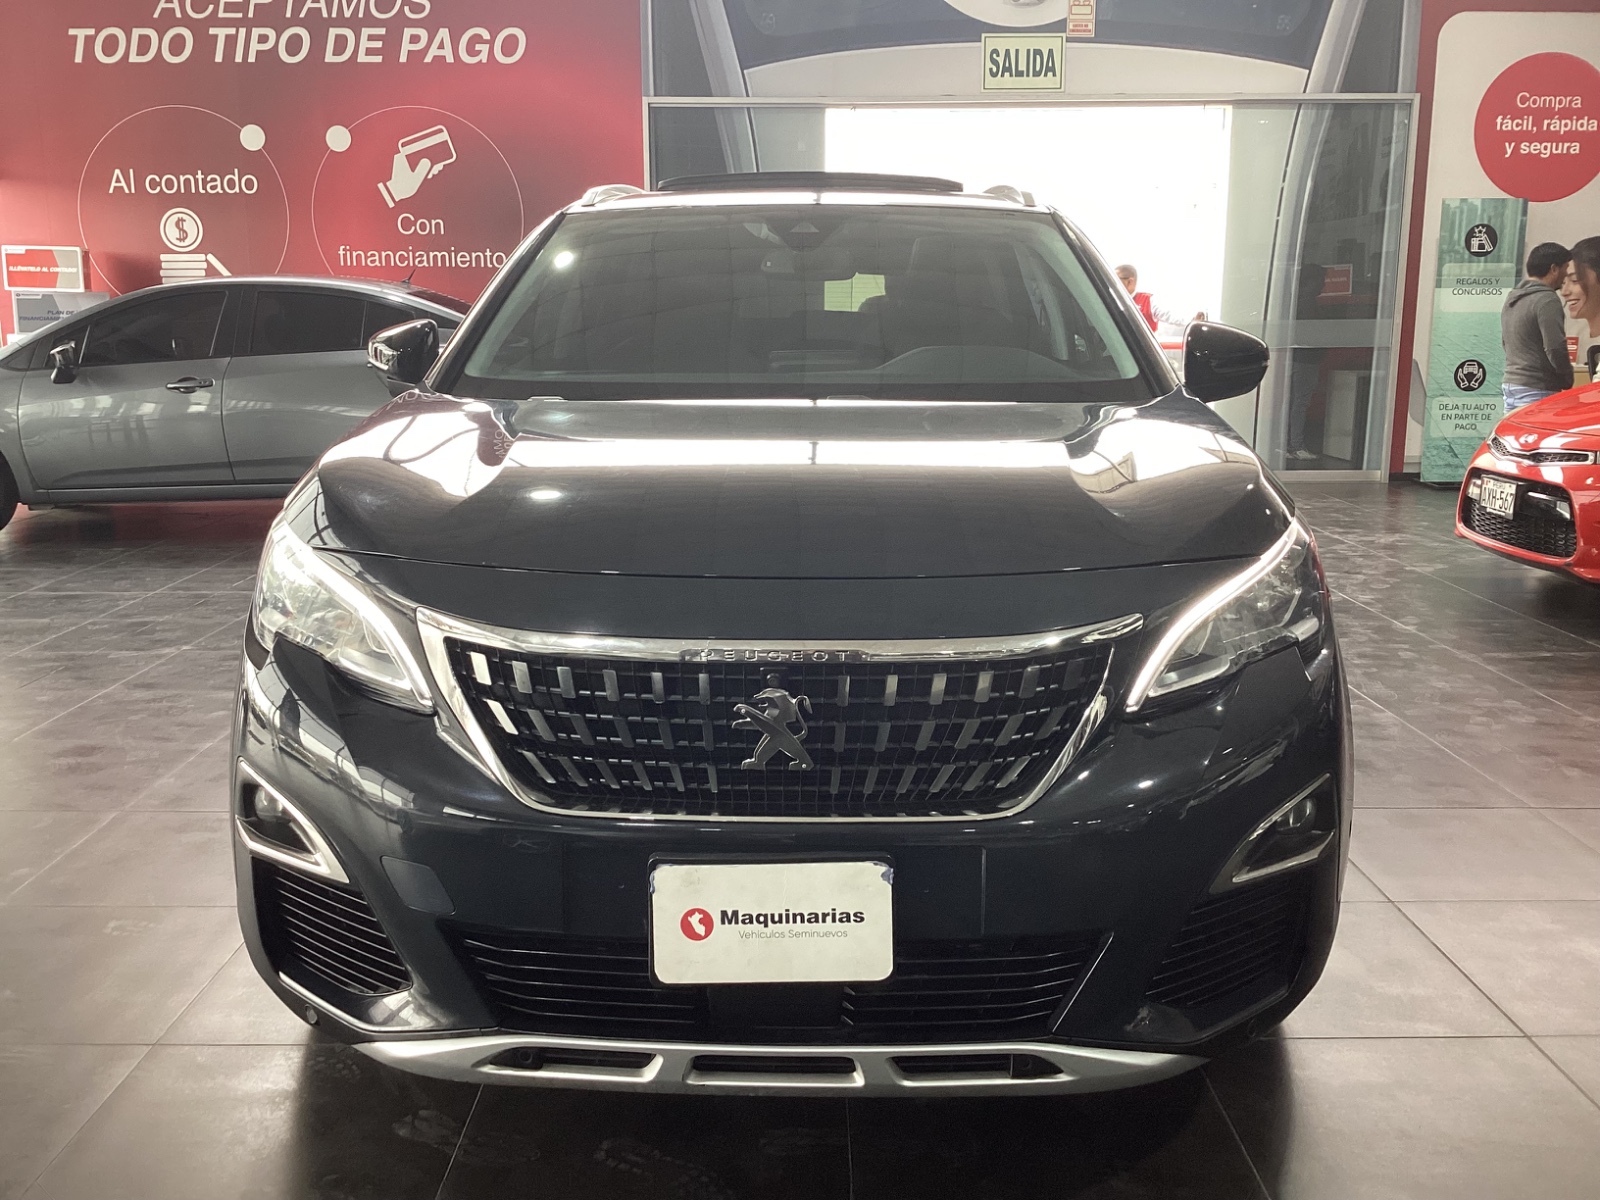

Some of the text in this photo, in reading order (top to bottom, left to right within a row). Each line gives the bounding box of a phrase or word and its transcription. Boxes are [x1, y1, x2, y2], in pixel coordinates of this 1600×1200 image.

[68, 26, 527, 64] TODO TIPO DE PAGO
[988, 48, 1057, 78] SALIDA
[1516, 92, 1582, 111] Compra
[1496, 115, 1598, 135] fácil, rápida
[1504, 142, 1580, 158] y segura
[108, 169, 258, 195] Al contado
[397, 213, 445, 235] Con
[338, 246, 506, 268] financiamiento
[1441, 413, 1492, 421] EN PARTE DE
[1454, 423, 1477, 431] PAGO
[1482, 487, 1515, 511] AXH-567
[700, 650, 850, 662] PEUGEOT
[720, 908, 865, 928] Maquinarias
[738, 929, 848, 939] Vehículos Seminuevos
